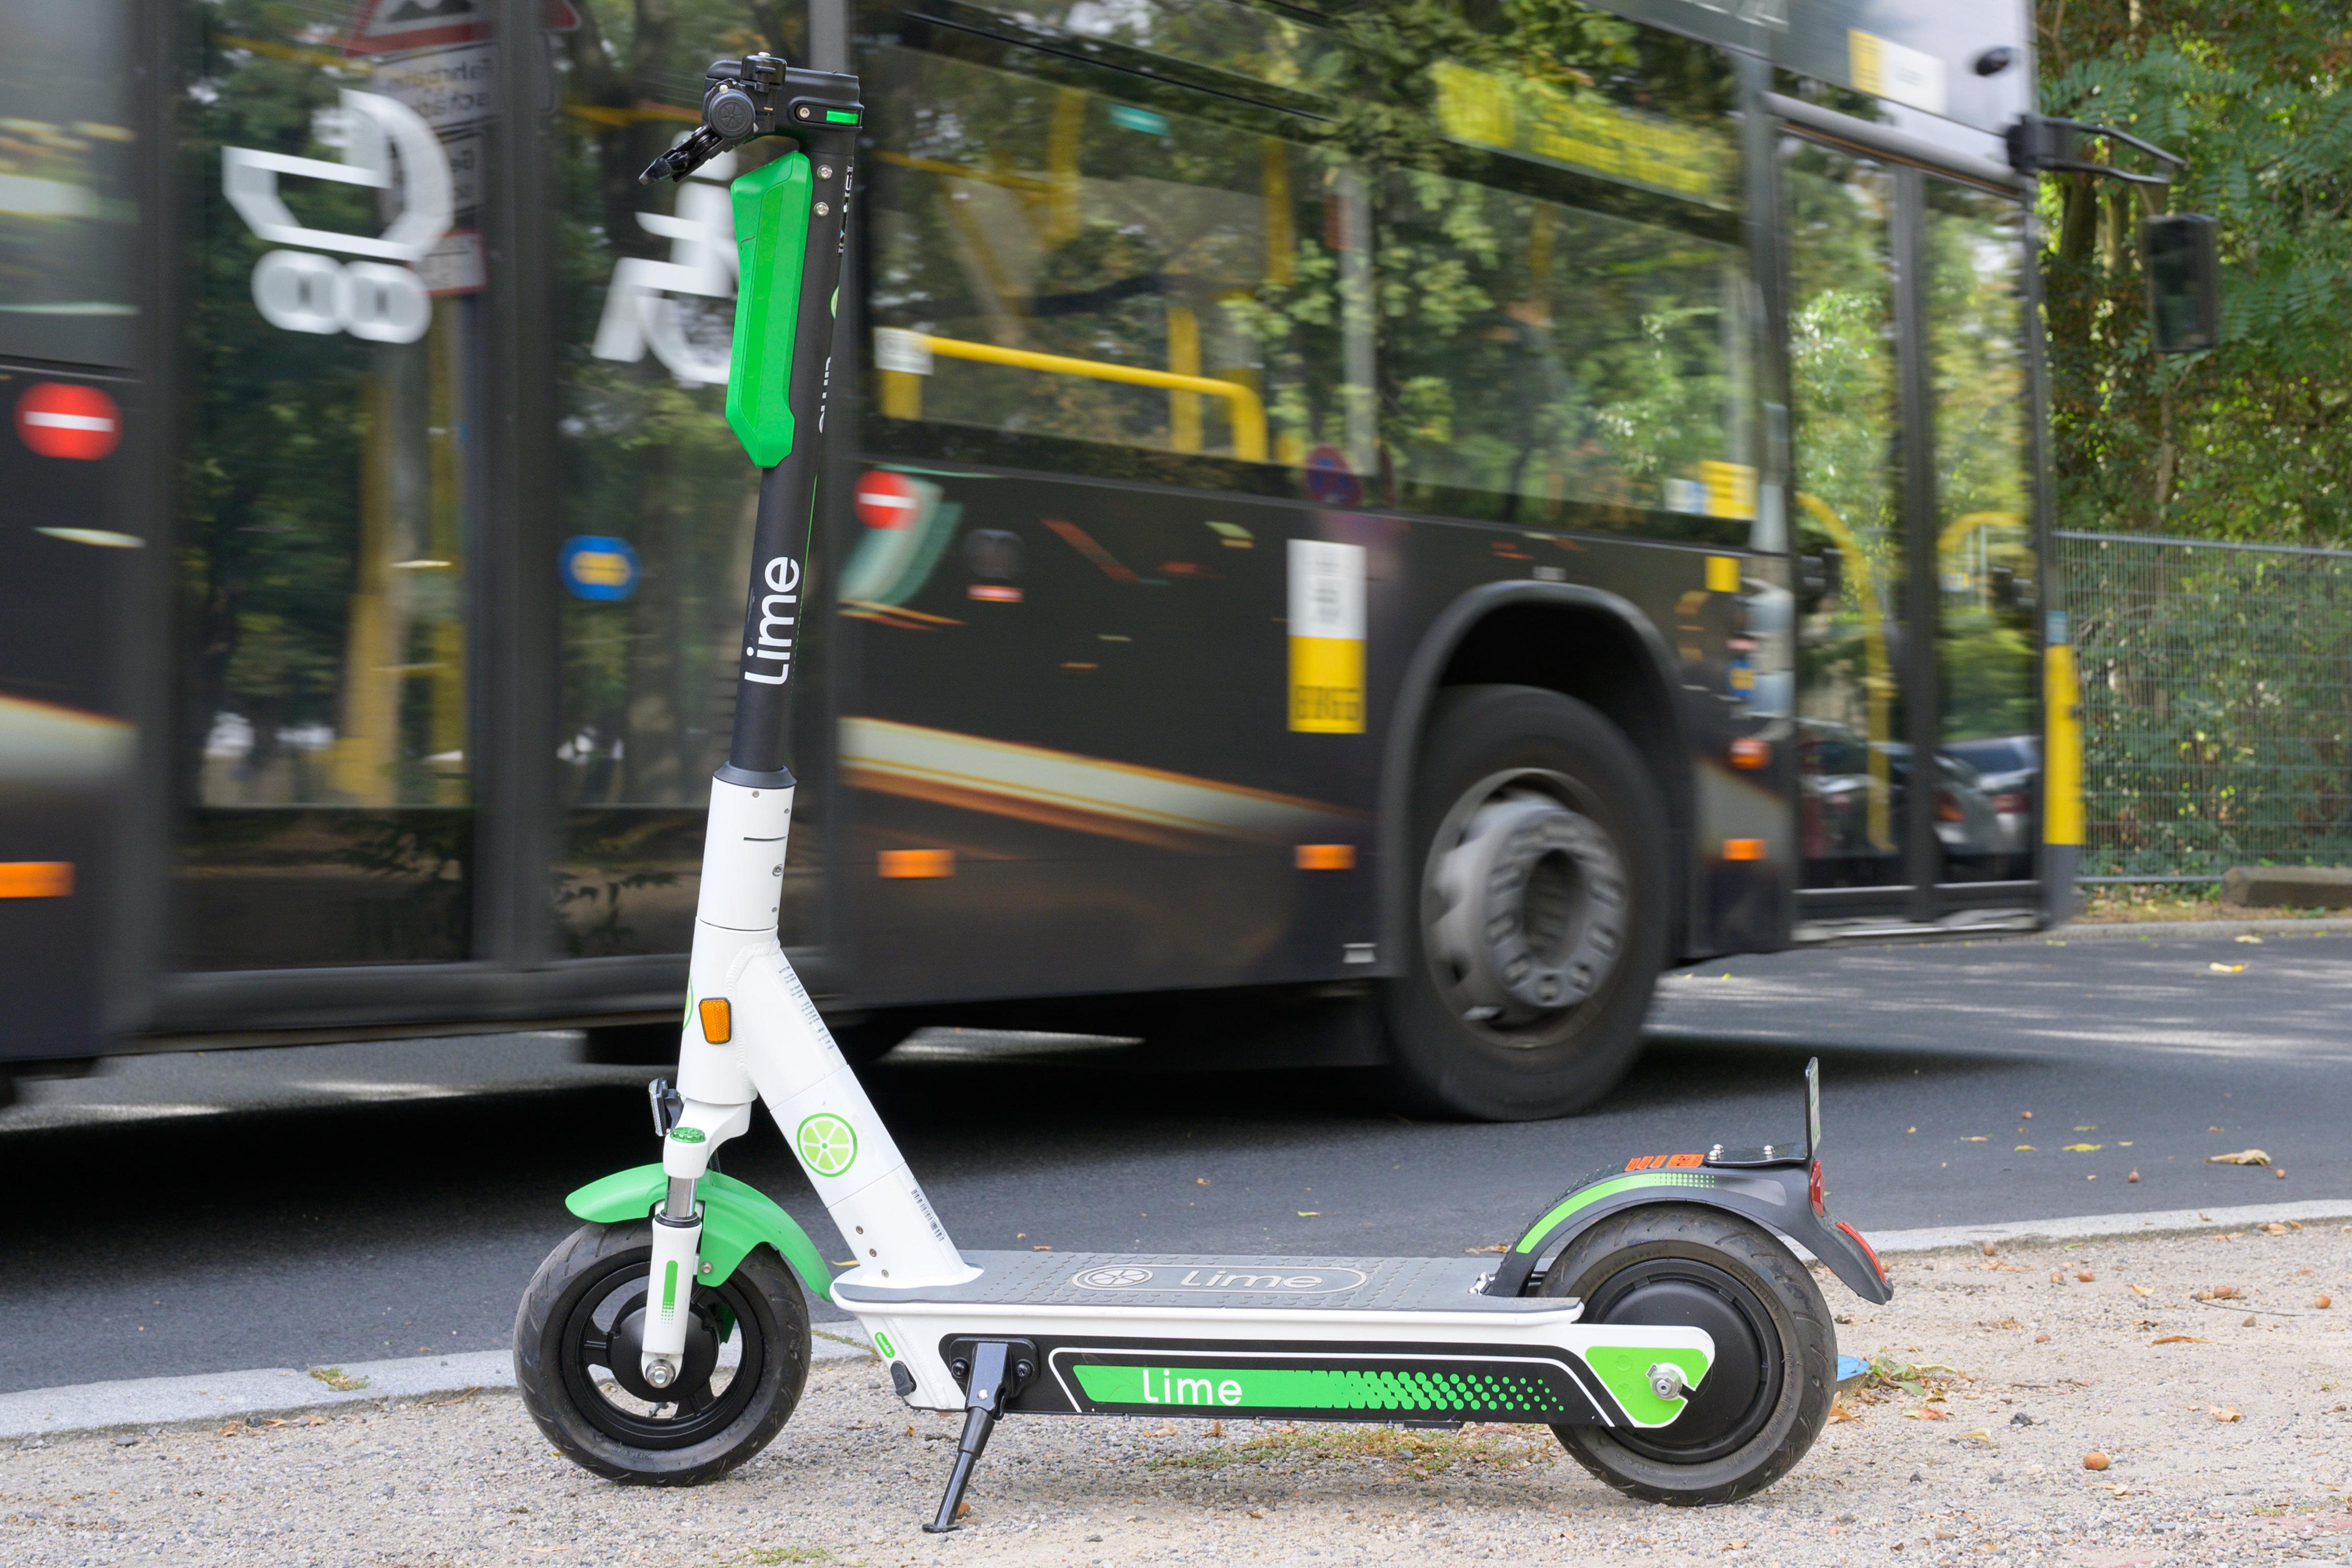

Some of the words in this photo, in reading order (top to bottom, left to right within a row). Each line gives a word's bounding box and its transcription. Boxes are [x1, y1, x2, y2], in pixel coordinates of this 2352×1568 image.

[744, 557, 800, 685] Lime
[1181, 1270, 1323, 1288] Lime
[1143, 1369, 1243, 1406] Lime
